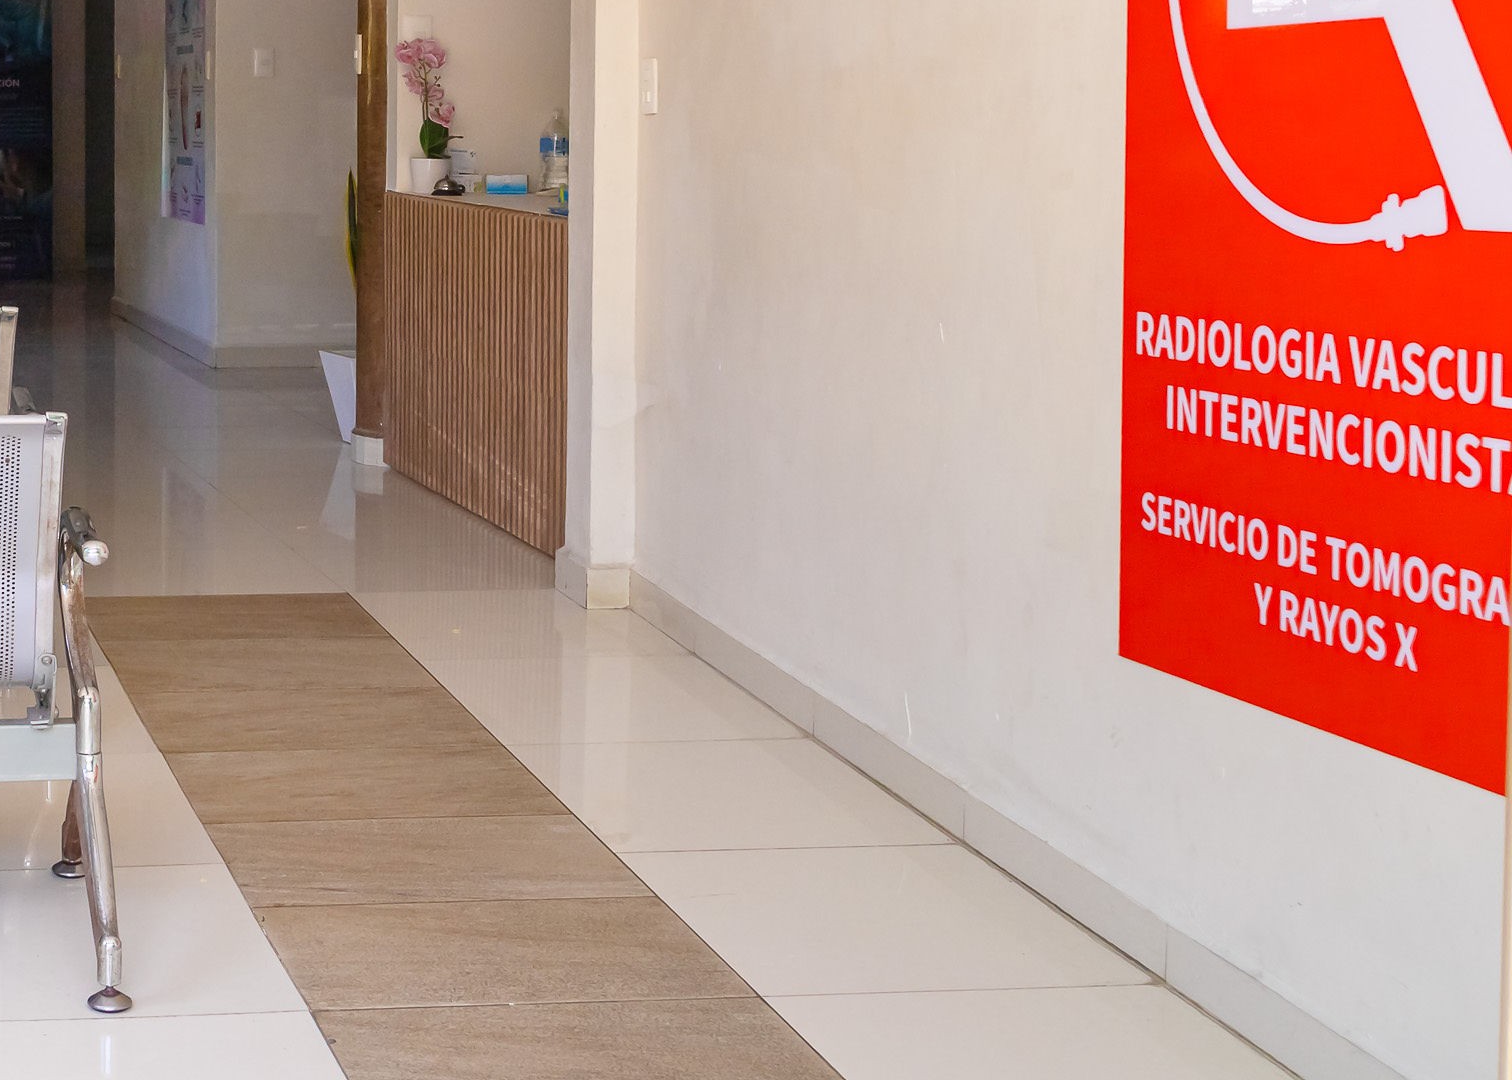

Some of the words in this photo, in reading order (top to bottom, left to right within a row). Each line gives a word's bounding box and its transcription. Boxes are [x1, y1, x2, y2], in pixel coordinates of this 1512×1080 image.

[1136, 311, 1341, 385] RADIOLOGIA
[1348, 335, 1512, 410] VASCUL
[1166, 385, 1512, 497] INTERVENCIONIST
[1141, 491, 1269, 562] SERVICIO
[1277, 524, 1317, 576] DE
[1325, 536, 1511, 627] TOMOGRA
[1254, 582, 1273, 626] Y
[1279, 589, 1387, 662] RAYOS
[1394, 622, 1419, 673] X
